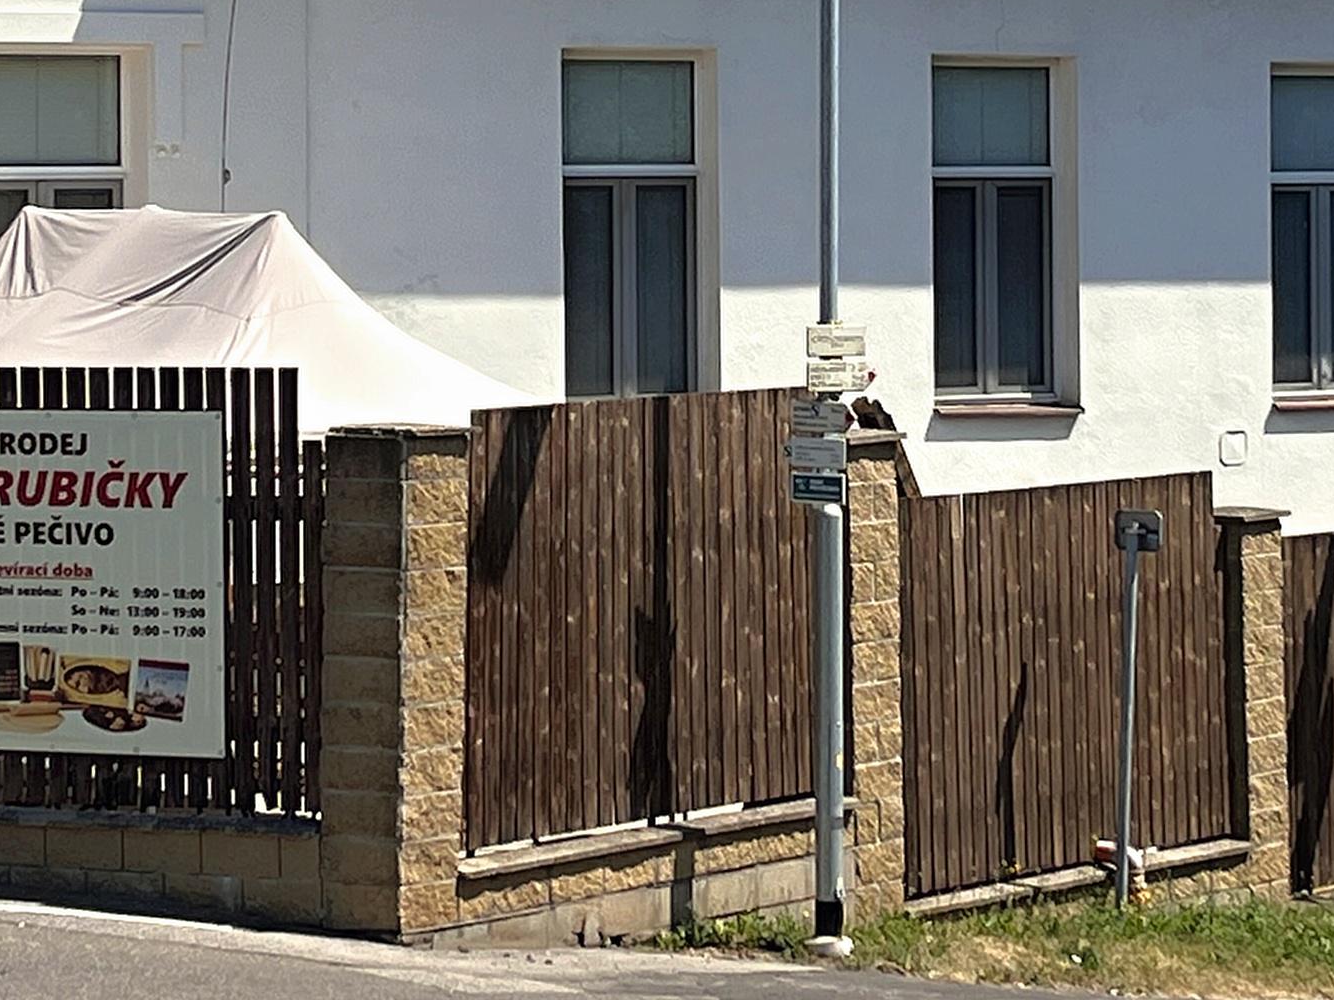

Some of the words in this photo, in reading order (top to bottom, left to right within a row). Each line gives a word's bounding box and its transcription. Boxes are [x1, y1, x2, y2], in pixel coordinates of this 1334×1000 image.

[14, 515, 115, 546] PEČIVO
[52, 562, 93, 578] doba
[70, 586, 87, 597] Po
[100, 586, 119, 598] Pá:
[132, 587, 160, 599] 9:00
[70, 604, 87, 616] So
[71, 623, 87, 634] Po
[100, 623, 119, 635] Pá:
[132, 624, 160, 636] 9:00
[173, 626, 206, 637] 17:00
